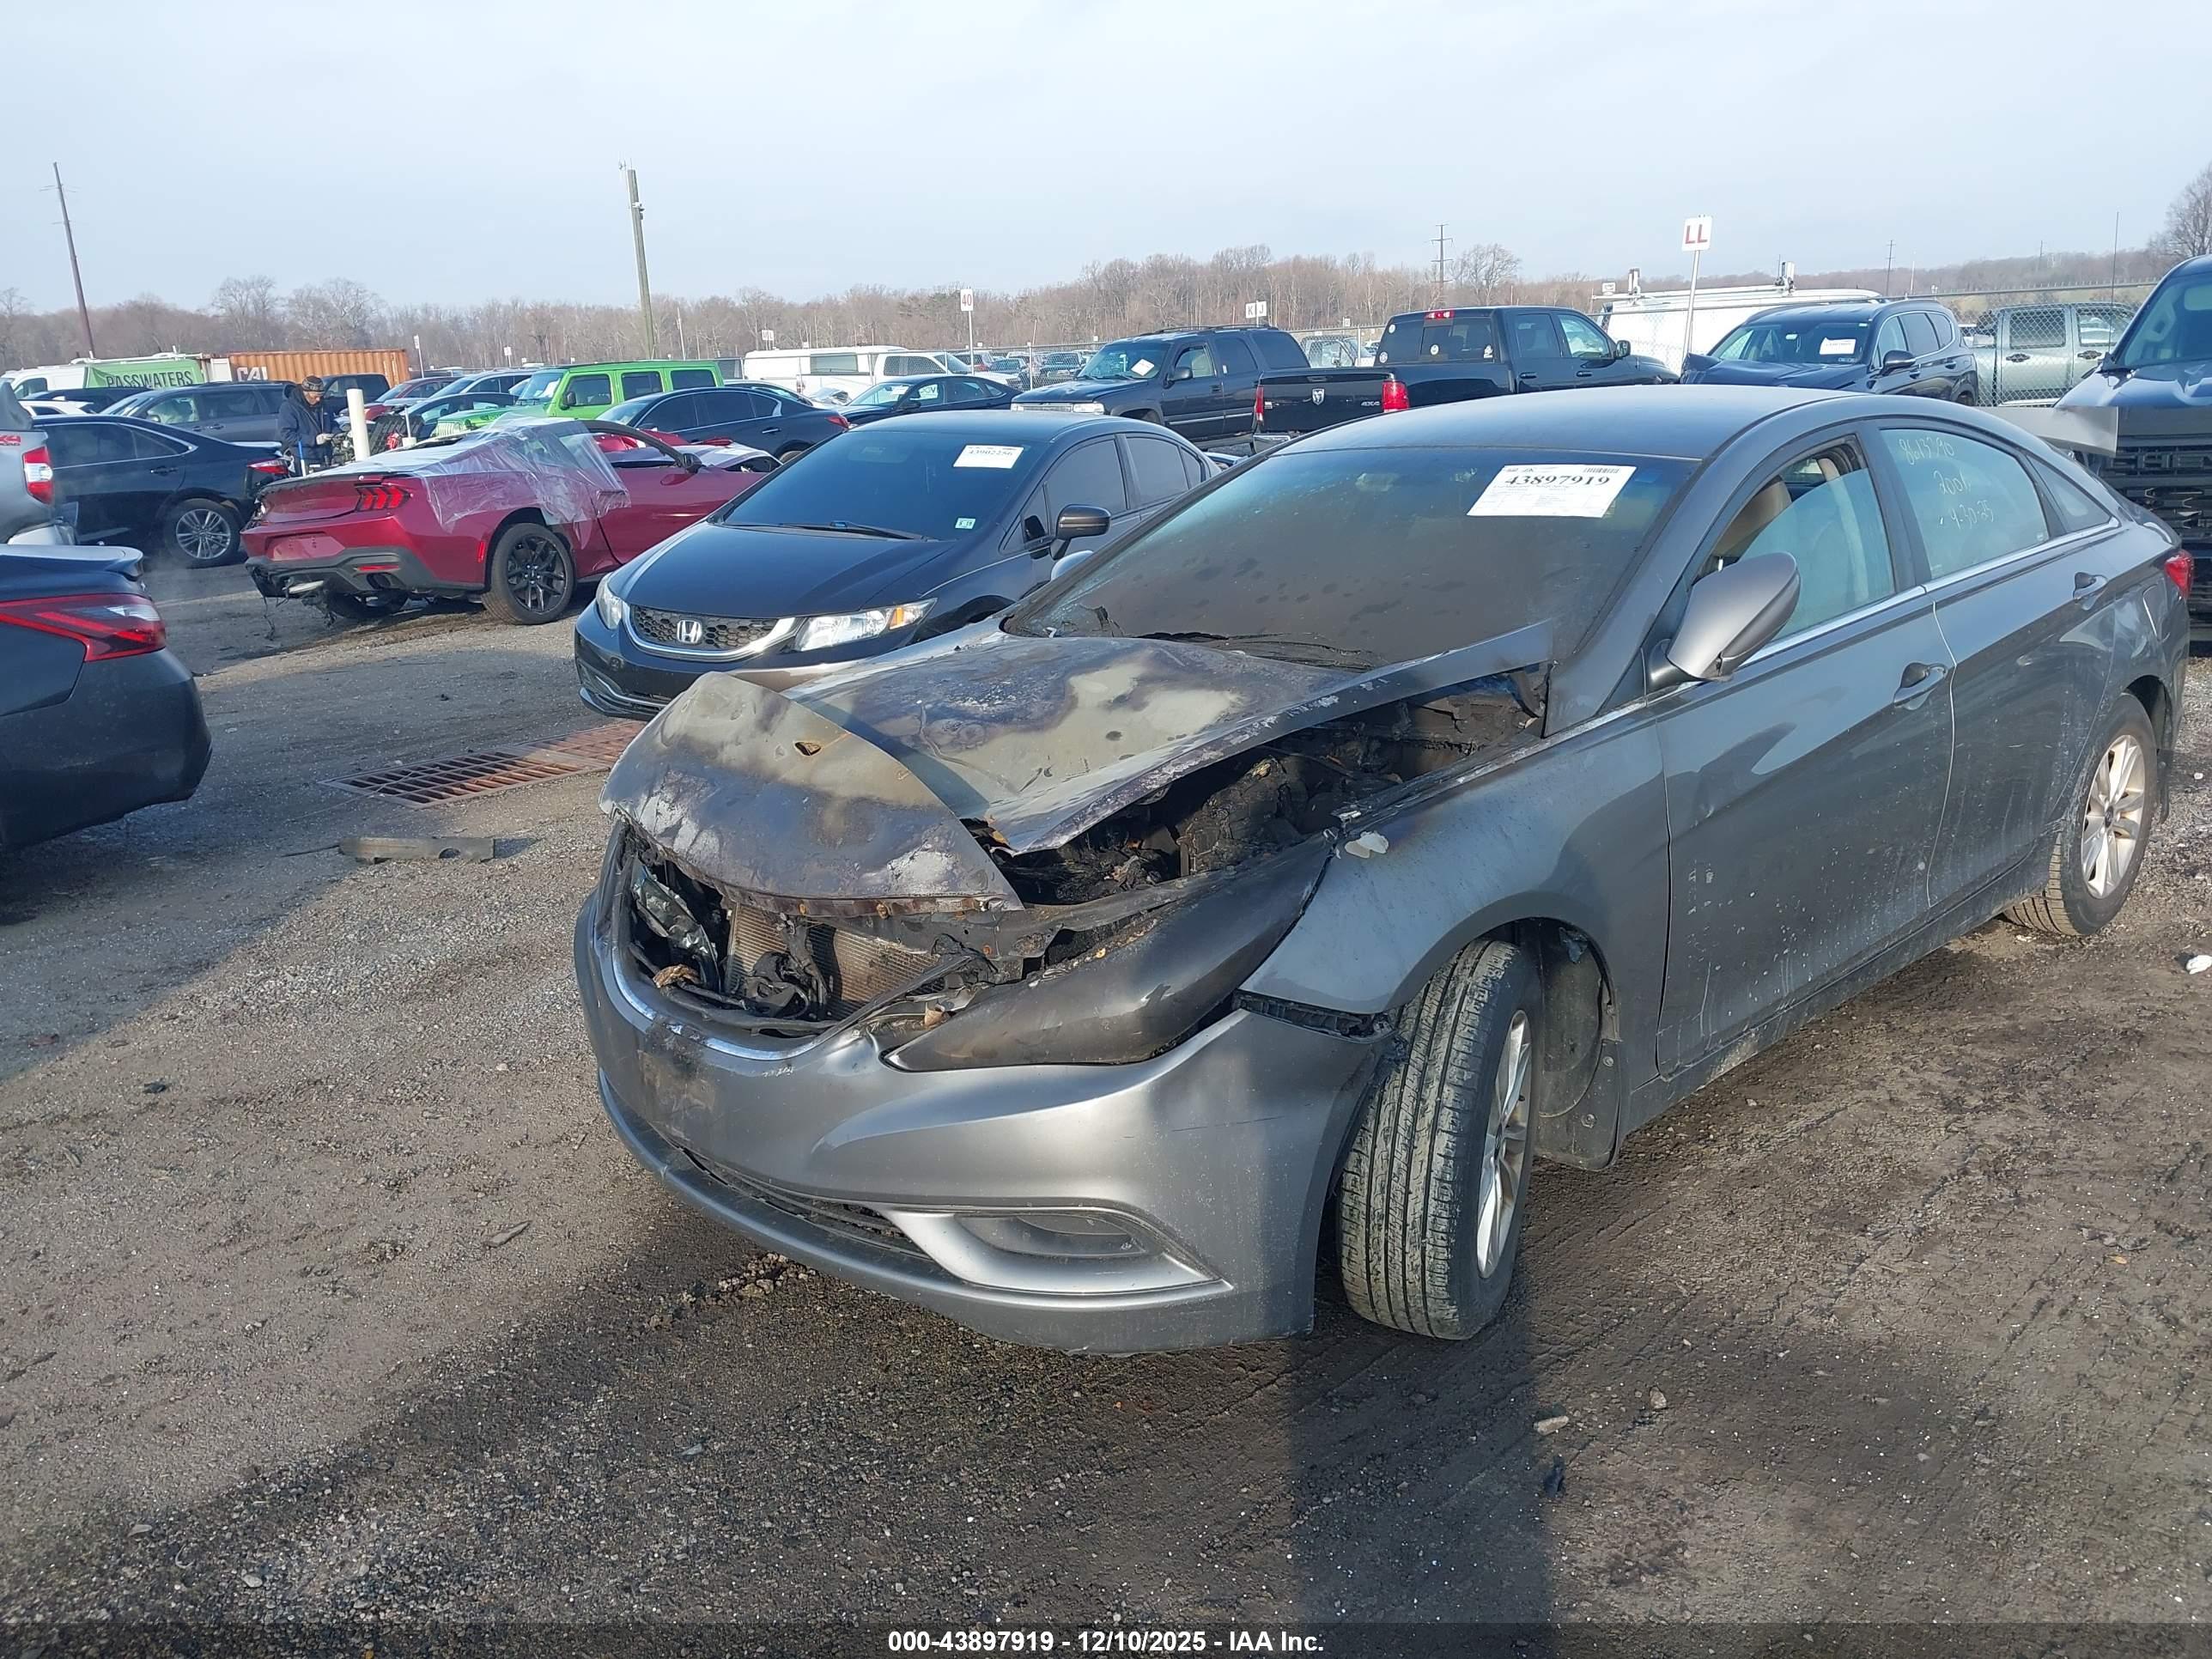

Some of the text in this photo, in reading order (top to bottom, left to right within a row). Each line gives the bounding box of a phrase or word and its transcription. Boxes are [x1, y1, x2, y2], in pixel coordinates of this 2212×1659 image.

[1685, 223, 1708, 244] LL
[962, 294, 972, 307] 40
[1248, 305, 1253, 316] K
[1260, 304, 1265, 315] J
[106, 370, 194, 388] PASSWATERS
[1504, 475, 1611, 486] 43897919
